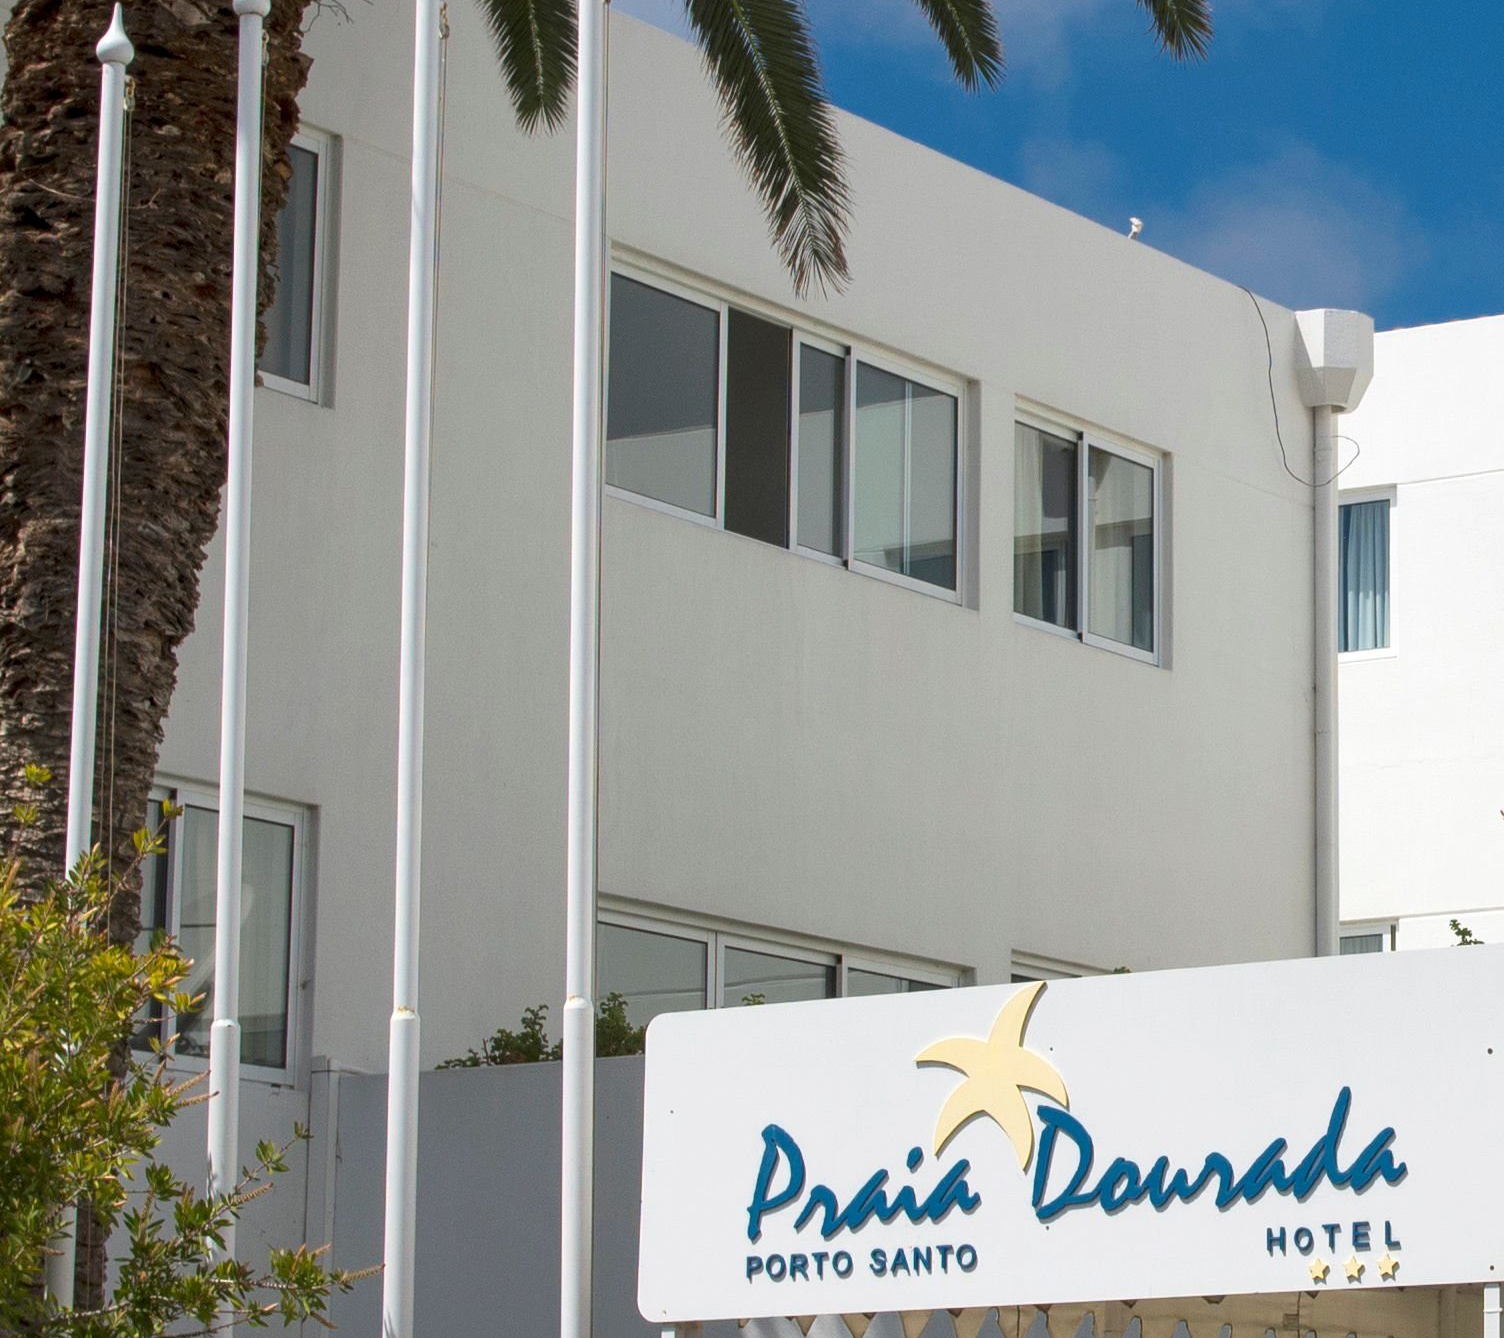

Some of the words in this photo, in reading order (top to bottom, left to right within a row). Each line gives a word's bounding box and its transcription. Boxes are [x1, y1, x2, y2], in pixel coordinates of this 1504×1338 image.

[747, 1124, 982, 1243] Praia
[1031, 1085, 1408, 1223] Dourada
[1266, 1220, 1401, 1256] HOTEL
[746, 1250, 854, 1283] PORTO
[869, 1244, 978, 1278] SANTO
